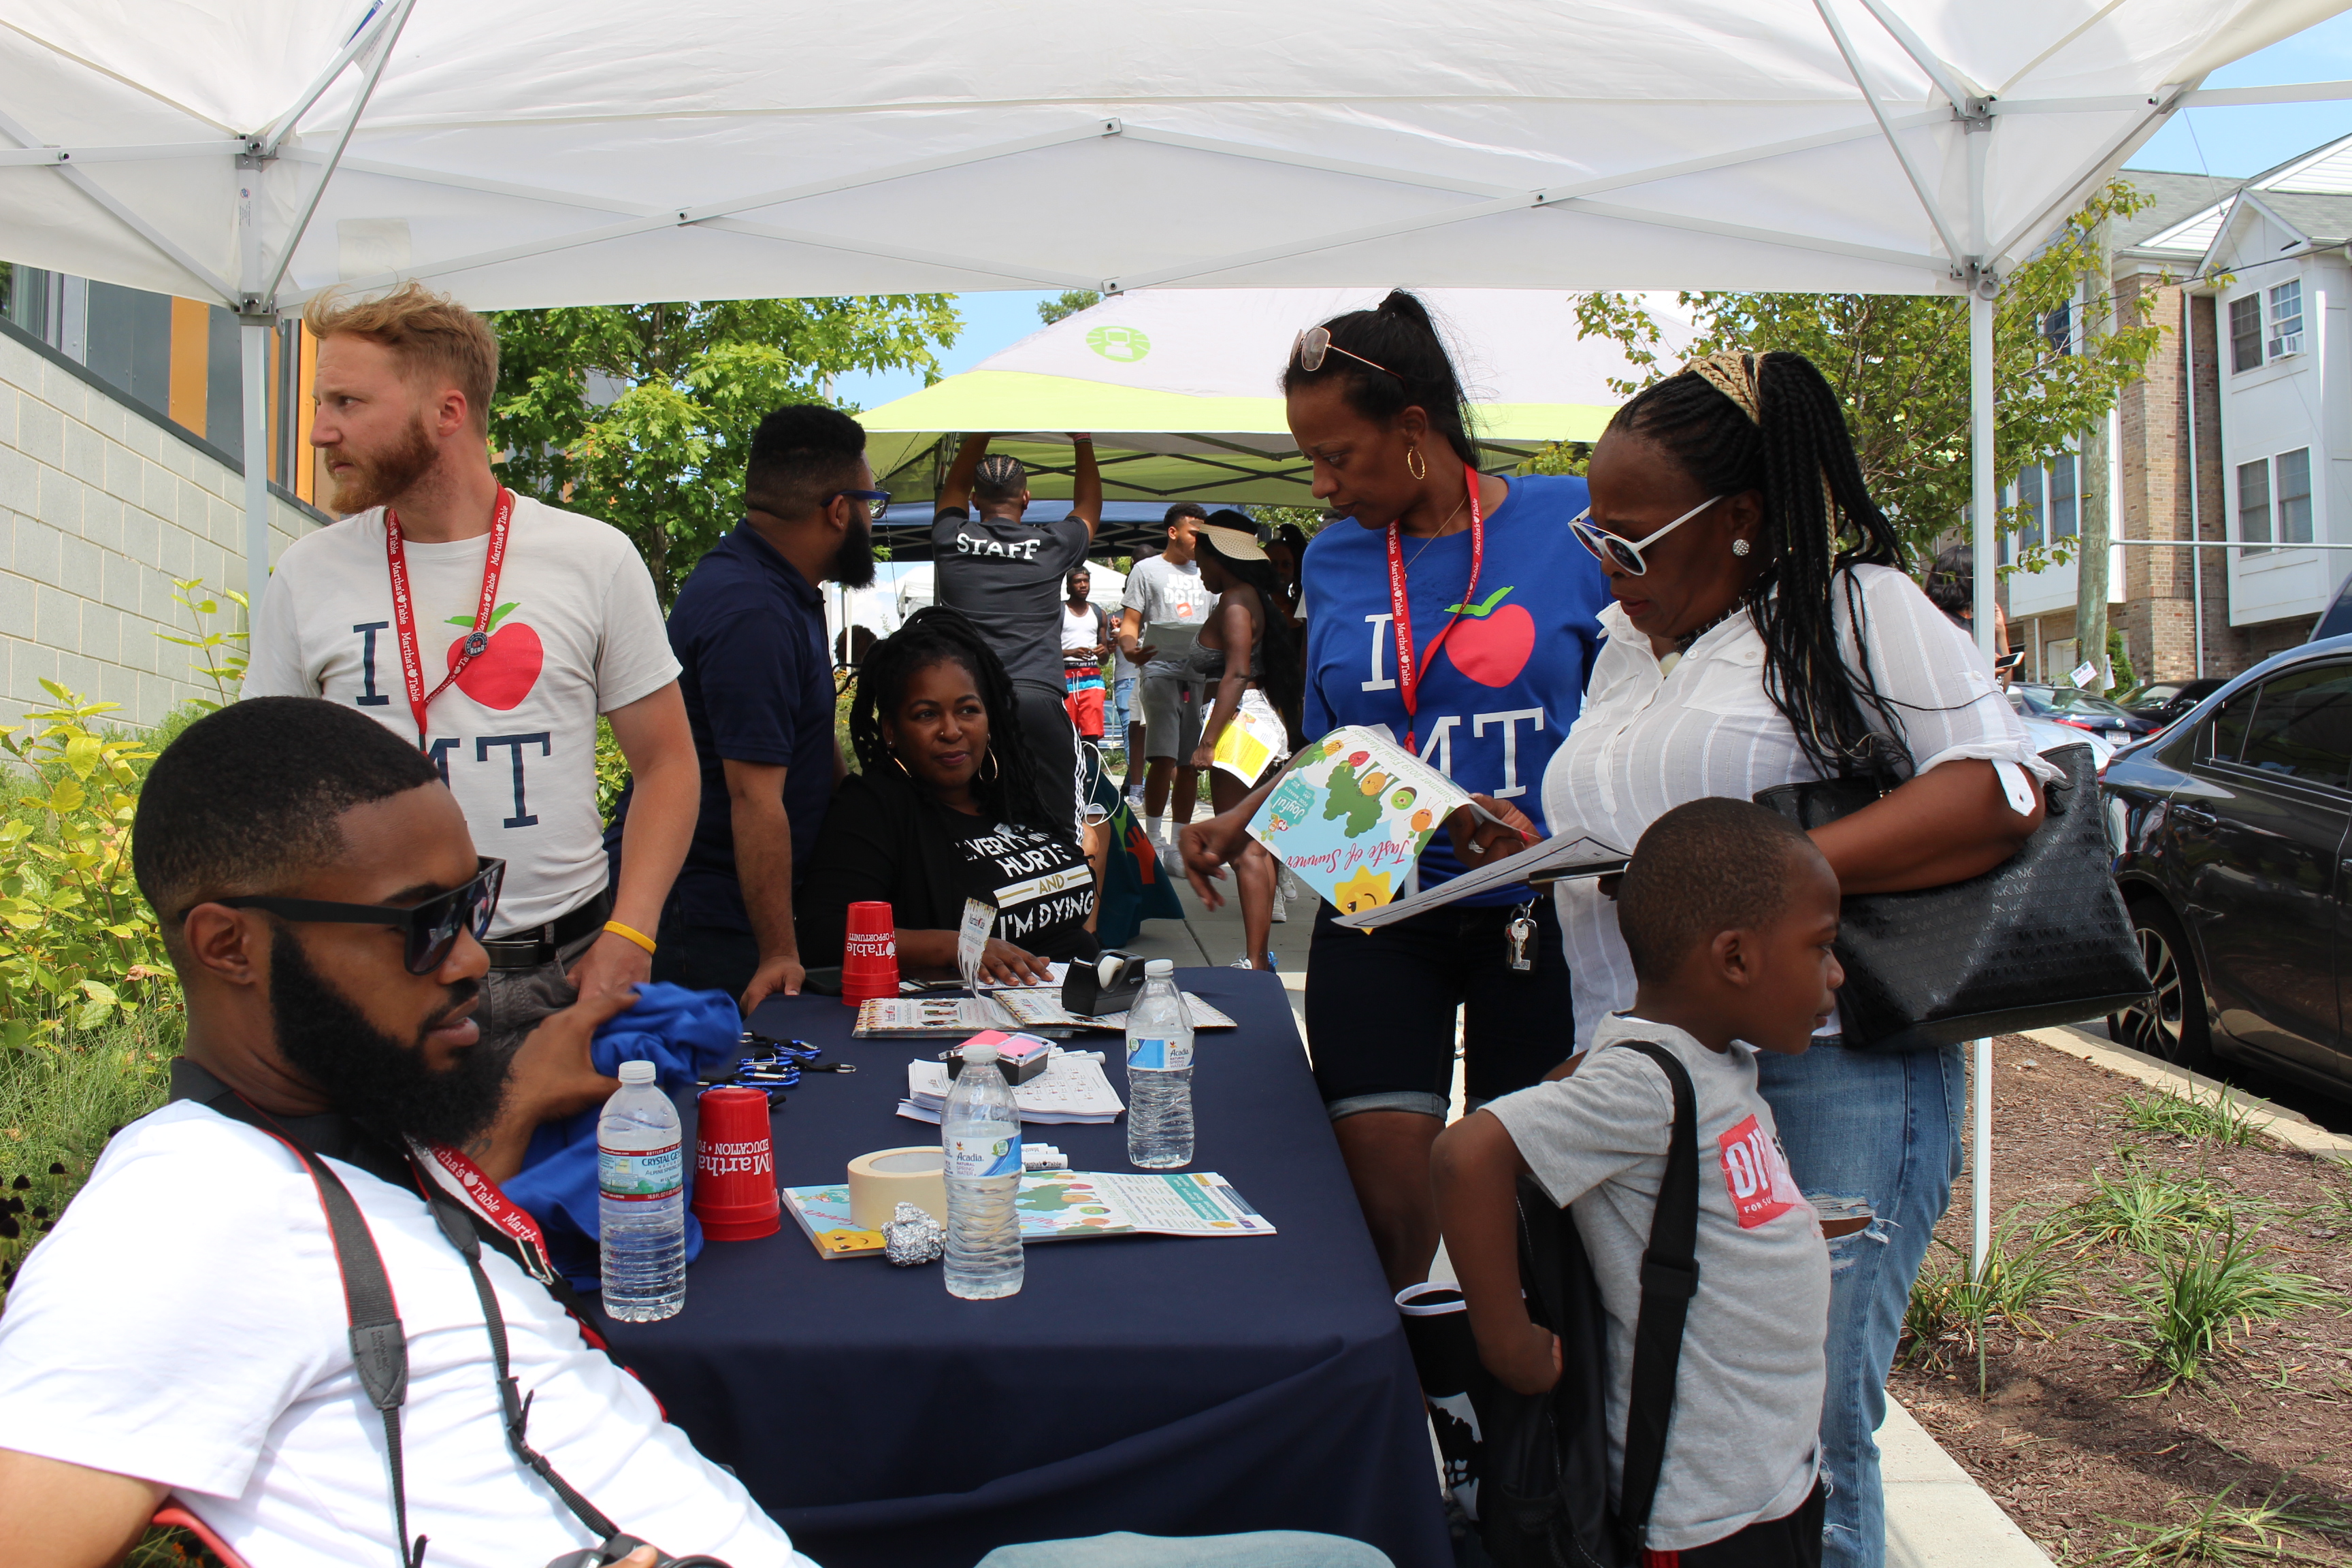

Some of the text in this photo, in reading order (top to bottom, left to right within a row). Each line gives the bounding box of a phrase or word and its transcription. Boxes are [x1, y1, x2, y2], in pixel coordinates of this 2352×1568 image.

[490, 505, 508, 566] Martha's Table
[957, 533, 1041, 559] STAFF
[392, 561, 408, 625] Martha's Table
[485, 572, 497, 594] Table
[1166, 574, 1200, 590] JUST
[1390, 560, 1403, 617] Martha's Table
[1164, 587, 1204, 606] DO IT.
[470, 644, 485, 654] READ
[1360, 613, 1396, 693] I
[1396, 623, 1411, 687] Martha's Table
[353, 621, 390, 706] I
[402, 632, 419, 702] Martha's Table
[425, 674, 457, 704] Martha's
[1352, 729, 1456, 804] Summer 2019 Final Markets
[1271, 796, 1306, 819] Joyful
[1298, 798, 1308, 808] FOOD
[1285, 840, 1410, 873] Taste of Summer
[1039, 874, 1065, 894] AND
[1000, 907, 1034, 941] I'M
[1039, 890, 1094, 928] DYING
[848, 932, 890, 942] OPPORTUNITY
[847, 942, 885, 957] Table
[1169, 1049, 1190, 1057] Acadia
[715, 1139, 770, 1155] EDUCATION
[956, 1152, 983, 1162] Acadia
[642, 1156, 670, 1166] CRYSTAL
[664, 1165, 679, 1173] SPRING
[472, 1182, 500, 1213] Table
[1744, 1202, 1763, 1214] FOR
